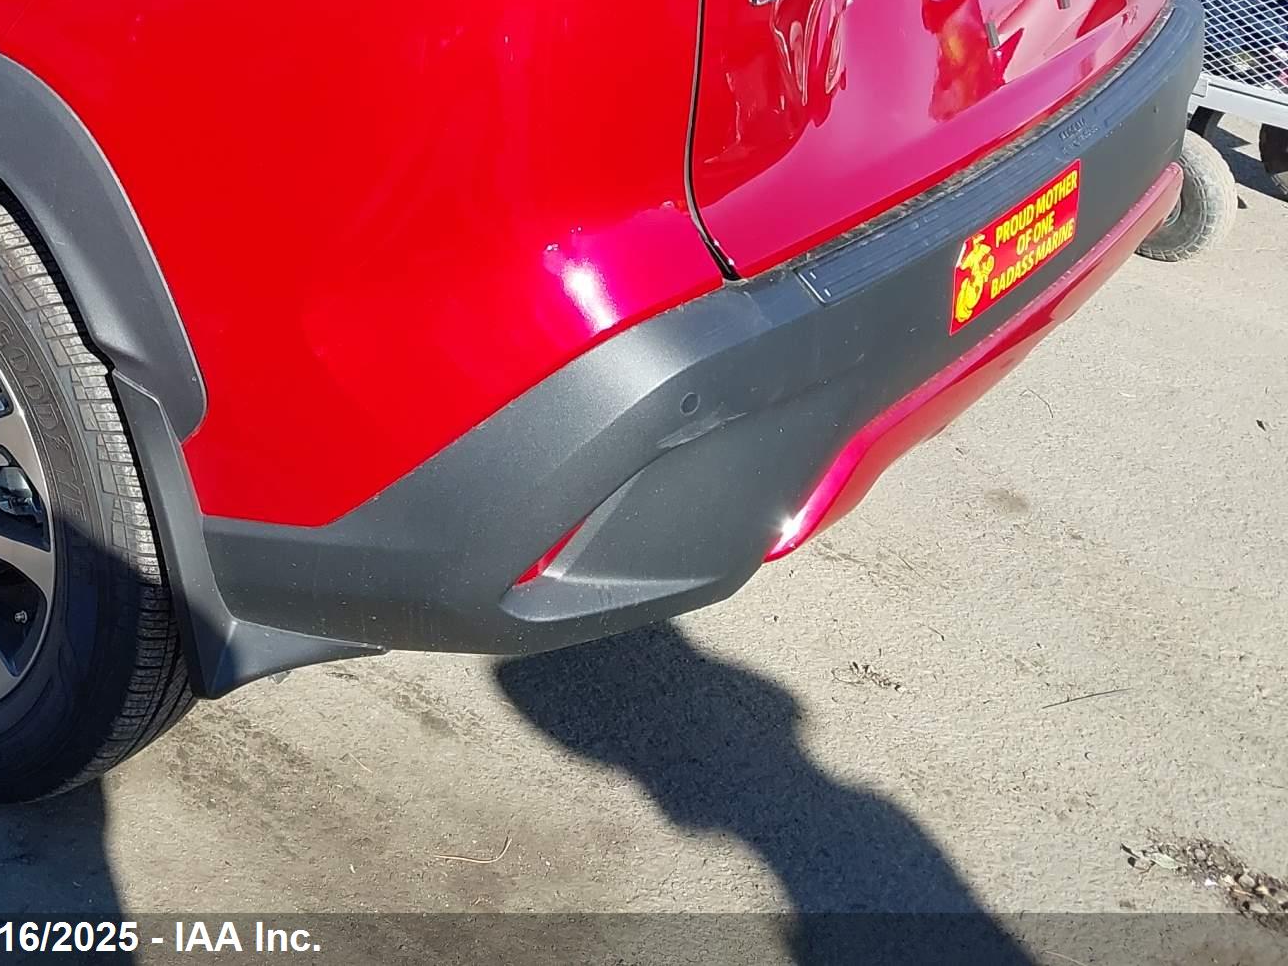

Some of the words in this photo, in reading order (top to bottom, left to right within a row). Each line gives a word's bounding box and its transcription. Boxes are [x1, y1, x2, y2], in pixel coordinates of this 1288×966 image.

[995, 205, 1035, 248] PROUD
[1035, 170, 1078, 218] MOTHER
[1016, 232, 1033, 255] OF
[1033, 211, 1056, 239] ONE
[990, 249, 1036, 299] BADASS
[1035, 218, 1075, 265] MARINE
